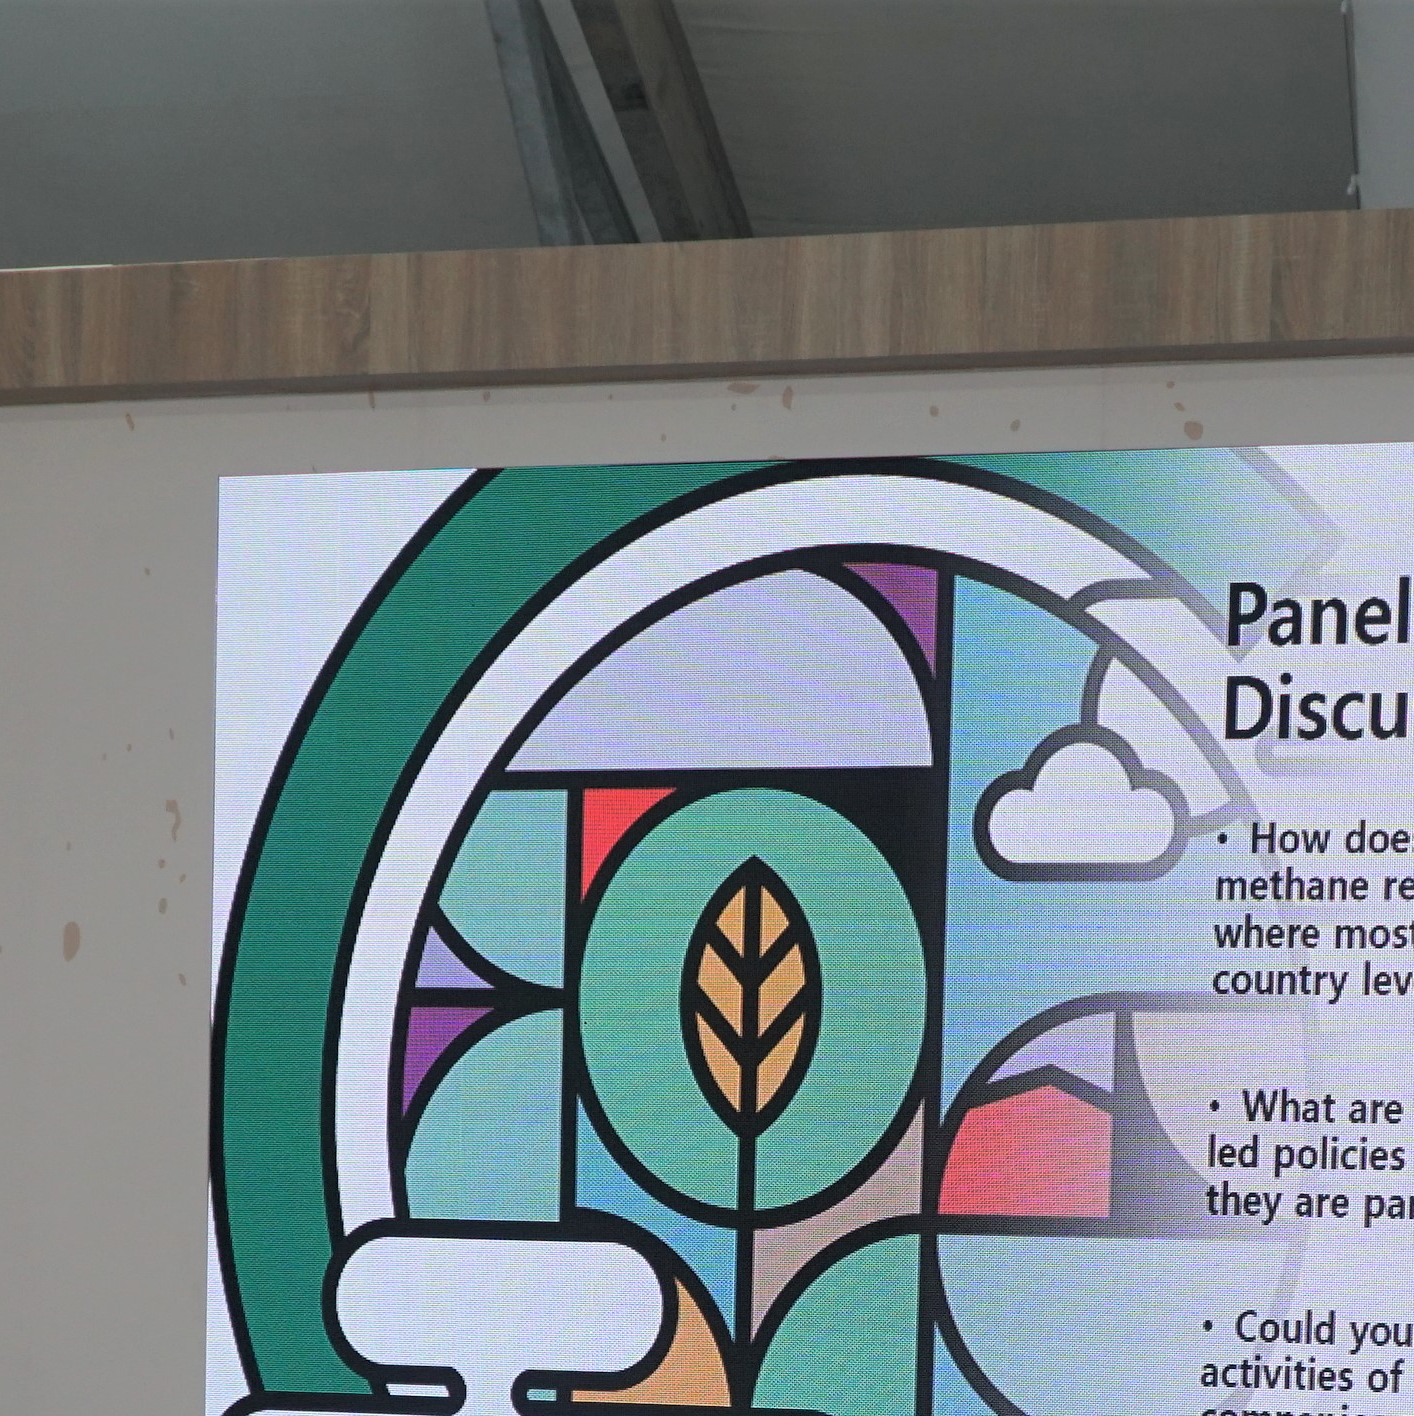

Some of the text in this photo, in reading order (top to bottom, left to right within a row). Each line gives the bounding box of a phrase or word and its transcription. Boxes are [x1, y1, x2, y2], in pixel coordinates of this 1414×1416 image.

[1227, 575, 1411, 647] Panel
[1251, 821, 1331, 855] How
[1216, 866, 1369, 901] methane
[1213, 913, 1320, 949] where
[1212, 965, 1349, 1005] country
[1242, 1087, 1336, 1124] What
[1348, 1099, 1404, 1125] are
[1208, 1133, 1259, 1169] led
[1273, 1135, 1406, 1179] policies
[1205, 1180, 1282, 1226] they
[1294, 1192, 1350, 1219] are
[1235, 1309, 1336, 1345] Could
[1349, 1321, 1413, 1354] you
[1200, 1353, 1354, 1392] activities
[1367, 1358, 1405, 1394] of
